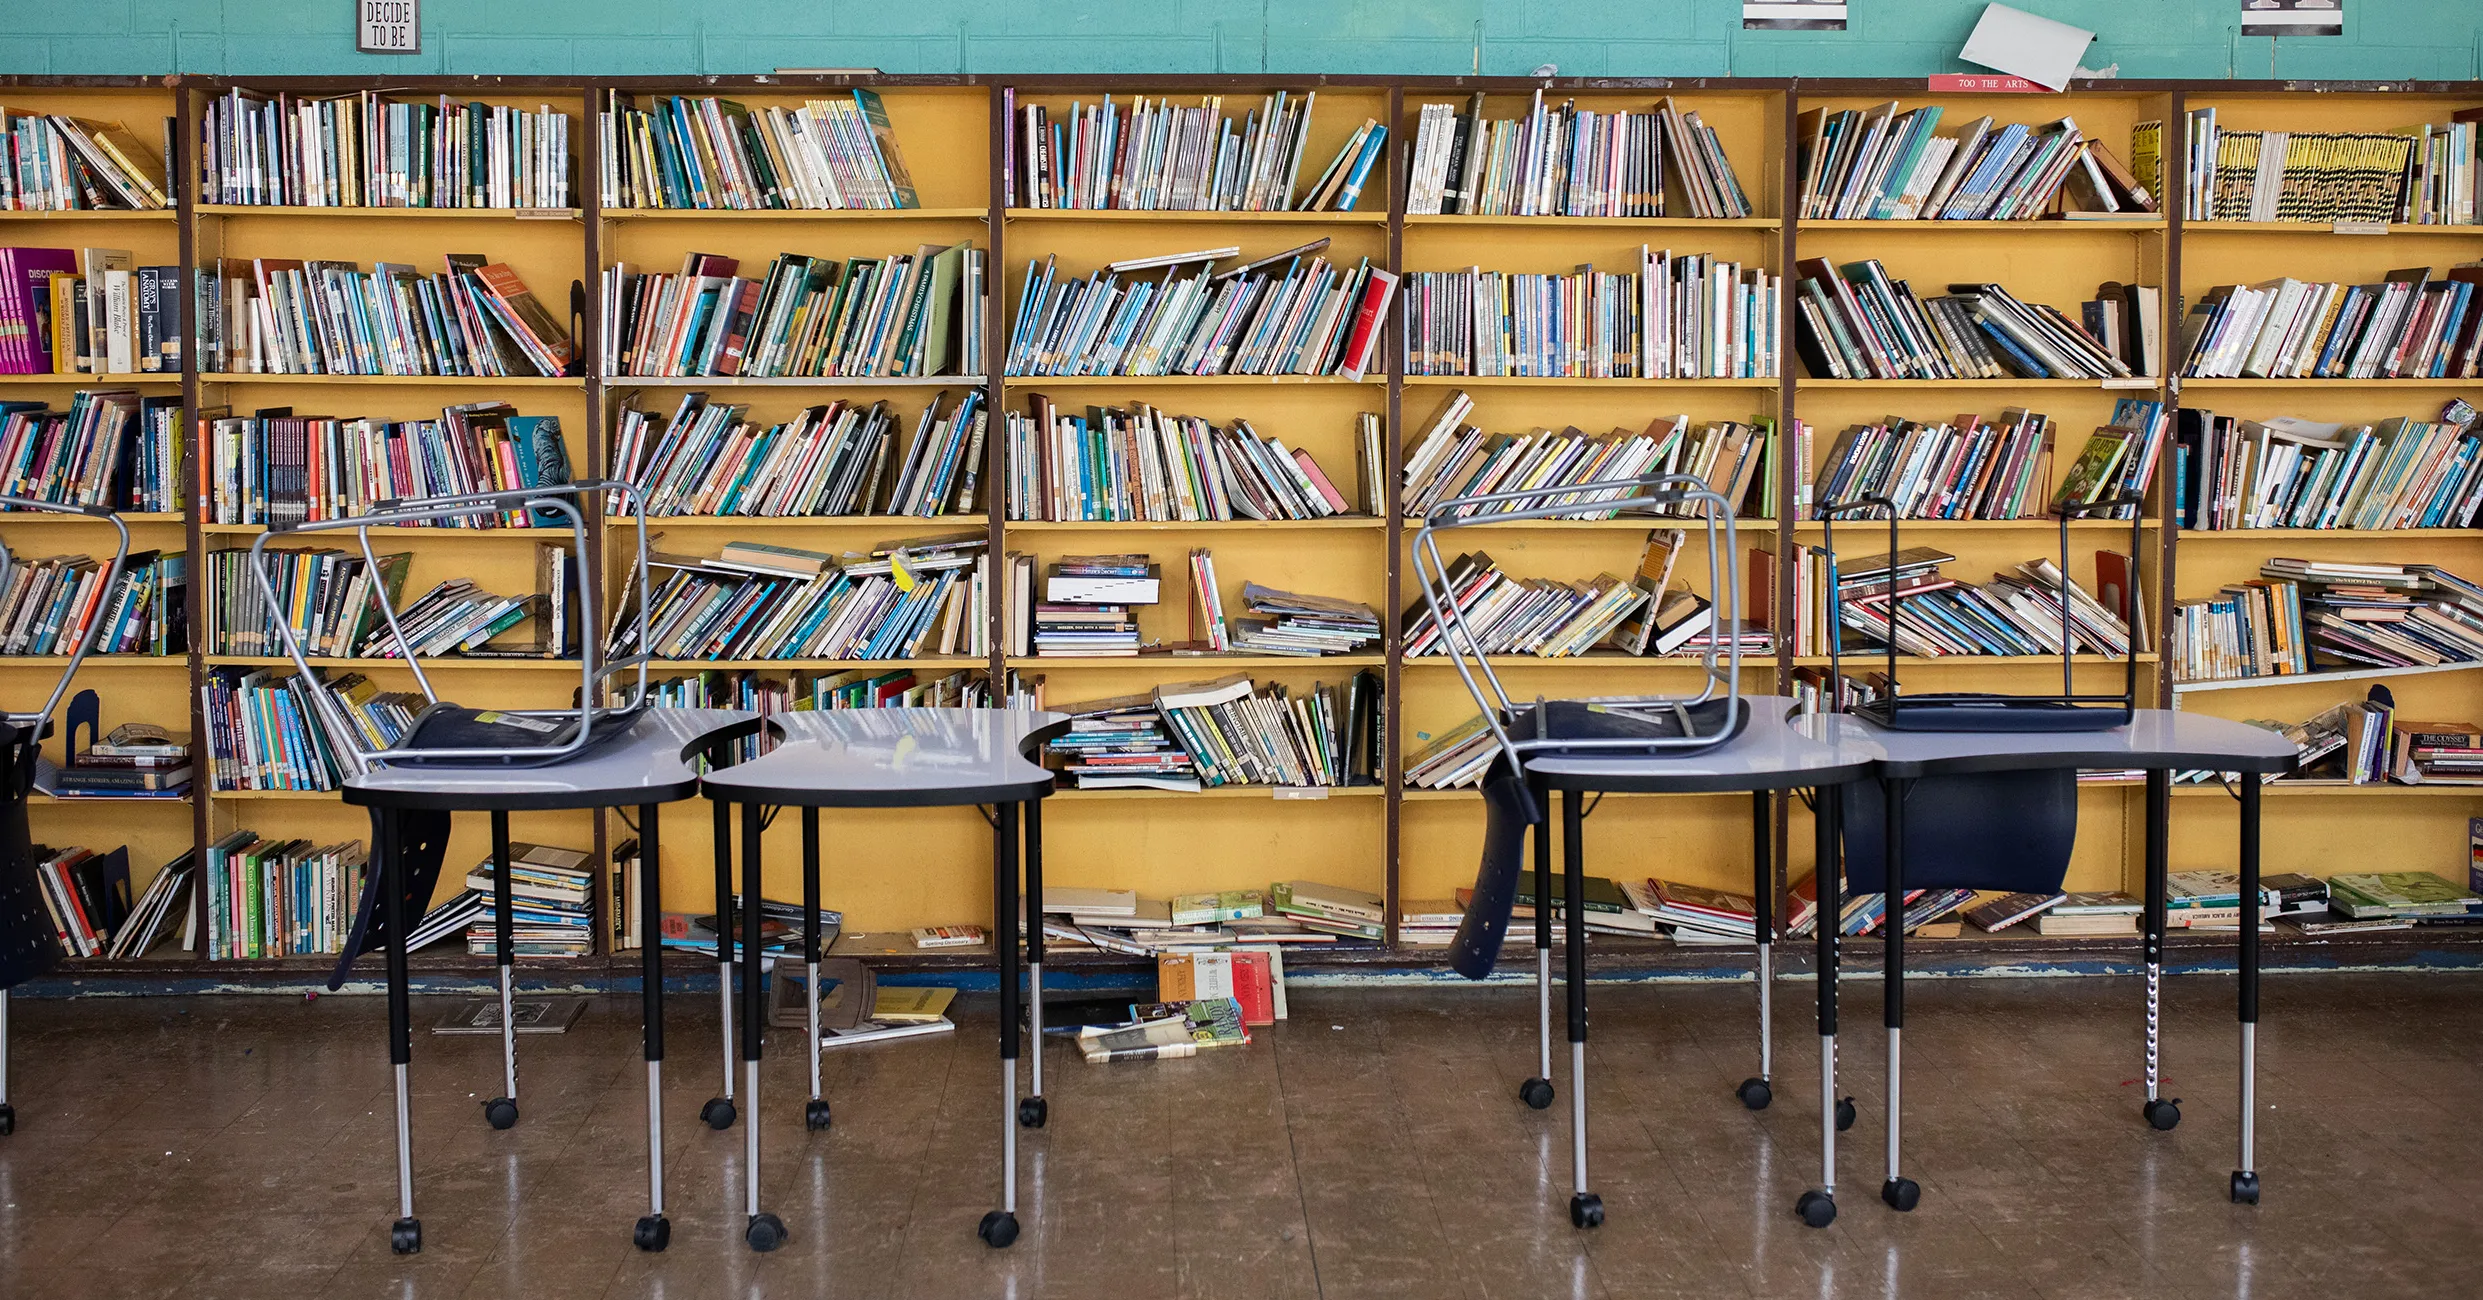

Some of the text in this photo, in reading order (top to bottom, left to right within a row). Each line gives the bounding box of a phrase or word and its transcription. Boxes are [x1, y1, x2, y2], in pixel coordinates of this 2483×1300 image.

[366, 2, 410, 24] DECIDE
[372, 26, 406, 48] TO BE
[1959, 78, 2028, 88] 700 THE ARTS
[136, 575, 150, 608] AIR
[762, 904, 795, 912] Countdown
[1217, 1005, 1230, 1038] RANDY
